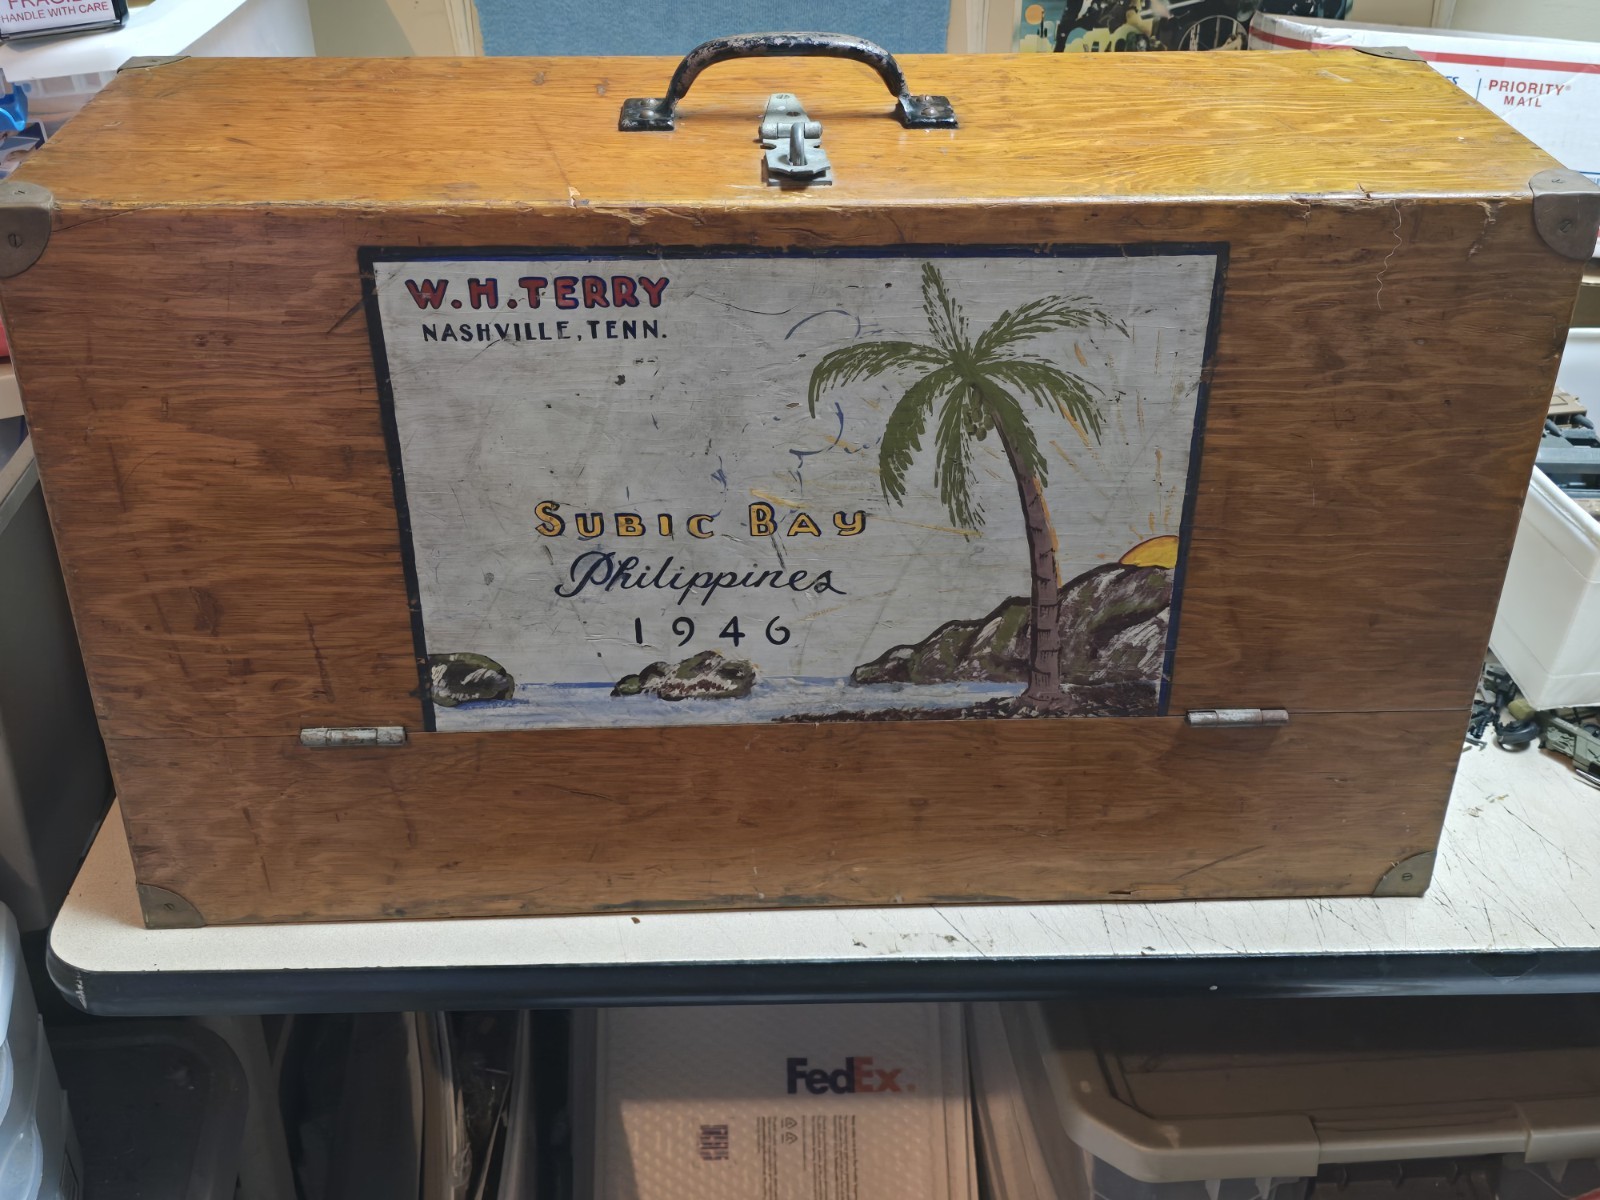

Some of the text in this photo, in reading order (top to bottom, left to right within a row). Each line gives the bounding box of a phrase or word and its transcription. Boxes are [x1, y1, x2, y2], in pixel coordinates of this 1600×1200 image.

[1, 10, 46, 23] HANDLE
[48, 6, 77, 18] WITH
[78, 2, 109, 13] CARE
[1503, 96, 1542, 108] MAIL
[554, 550, 848, 606] Philippines
[786, 1056, 902, 1095] FedEx
